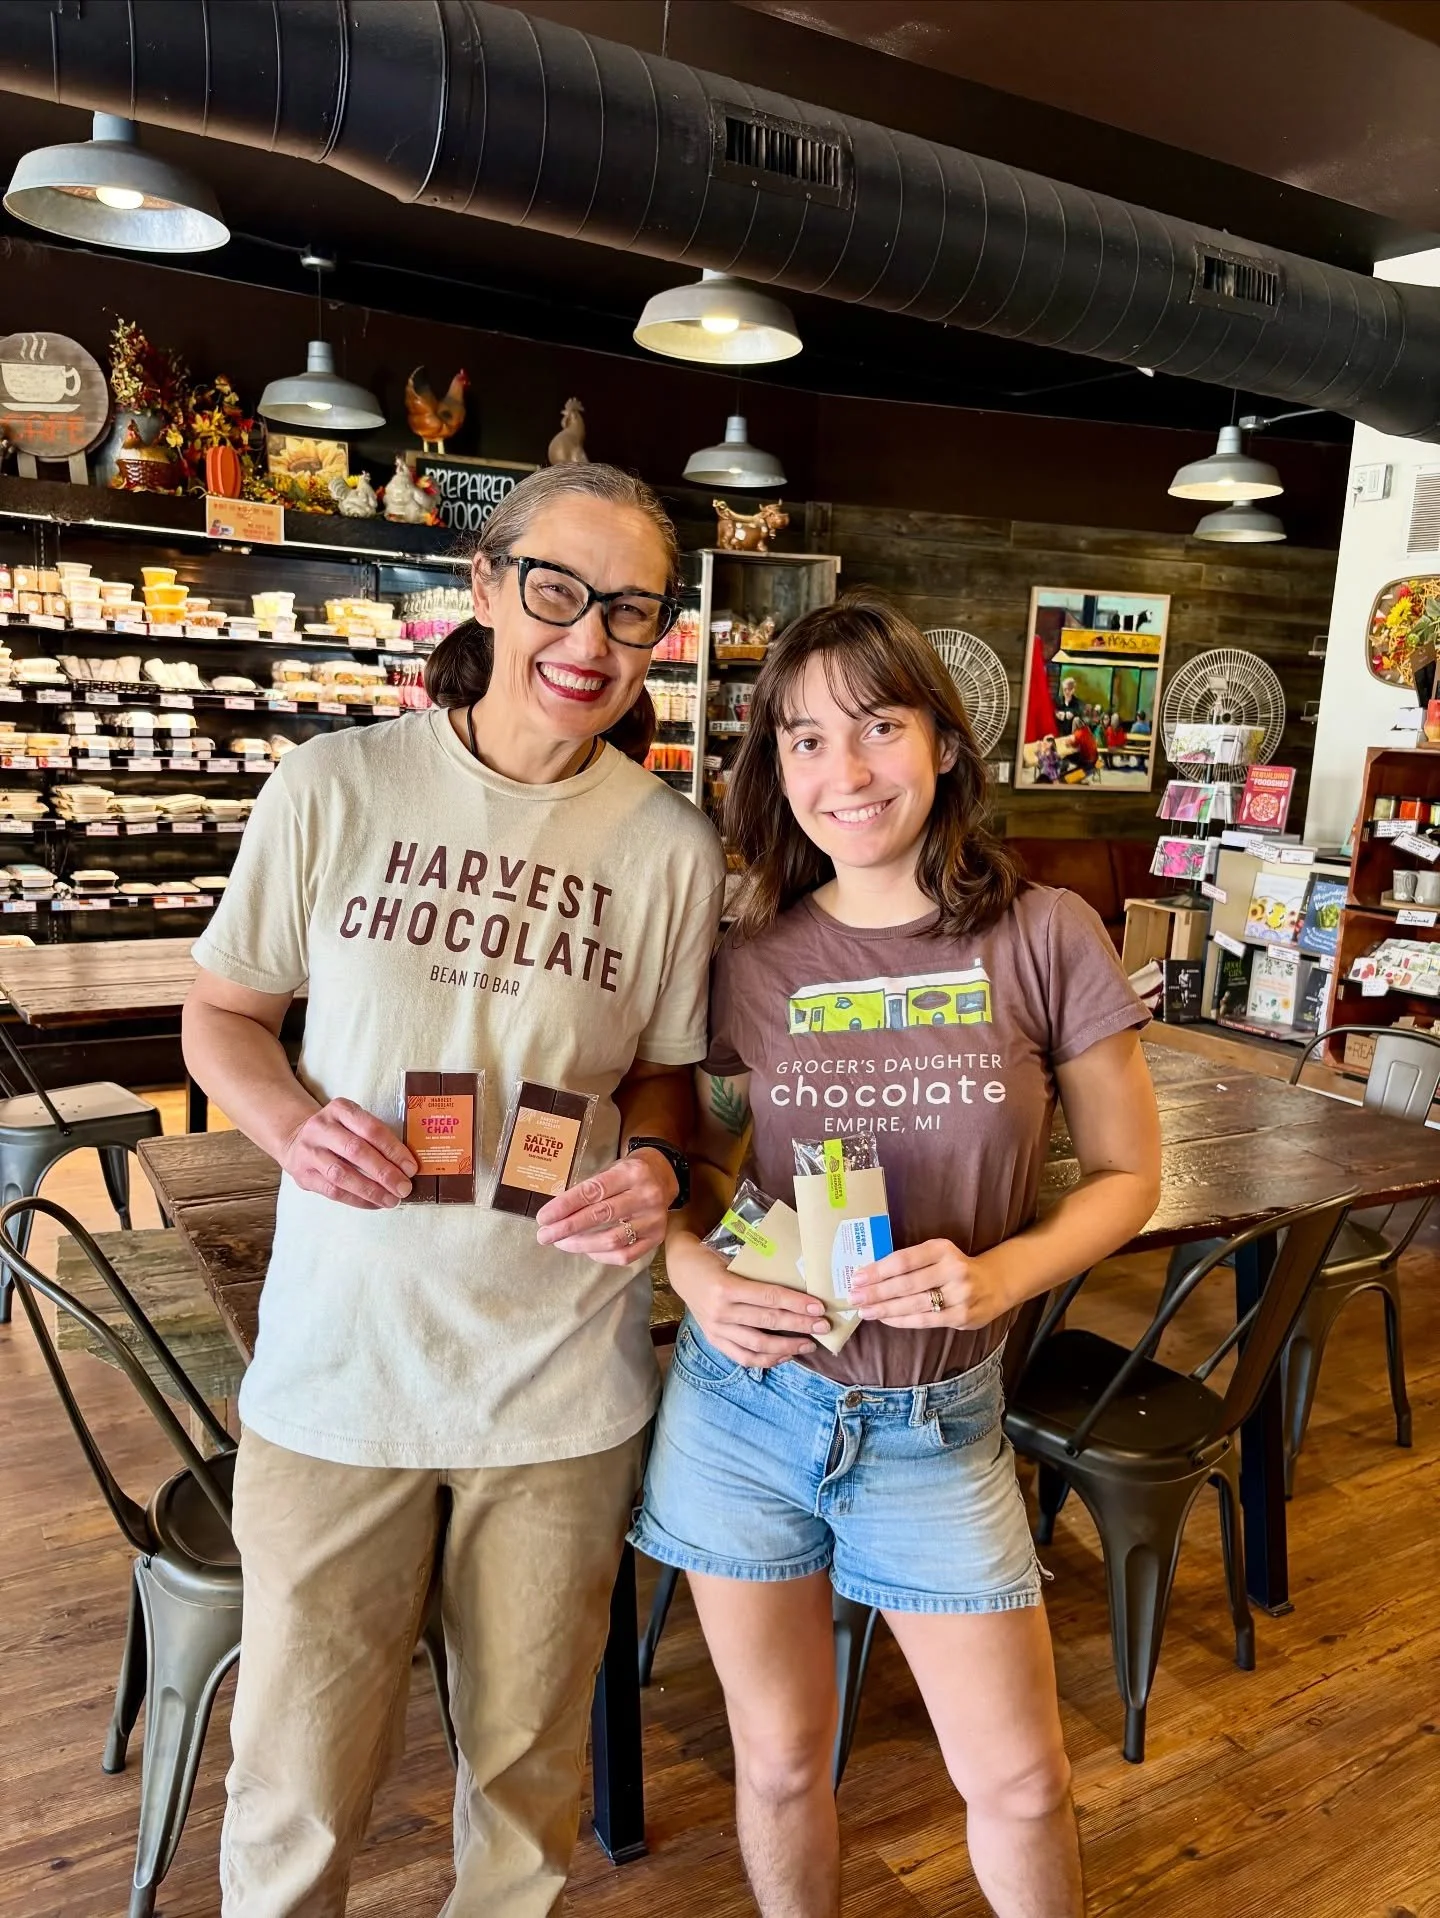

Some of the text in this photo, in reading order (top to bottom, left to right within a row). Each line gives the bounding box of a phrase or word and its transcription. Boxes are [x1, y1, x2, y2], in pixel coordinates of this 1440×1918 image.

[440, 500, 494, 532] OODS
[385, 841, 612, 927] HARVEST
[339, 895, 623, 993] CHOCOLATE
[430, 965, 521, 997] BEAN TO BAR
[776, 1053, 1003, 1074] GROCER'S DAUGHTER
[770, 1075, 1006, 1108] chocolate
[421, 1118, 460, 1126] SPICED
[427, 1126, 454, 1134] CHAI
[824, 1115, 941, 1134] EMPIRE, MI
[523, 1142, 560, 1158] MAPLE
[525, 1134, 564, 1150] SALTED
